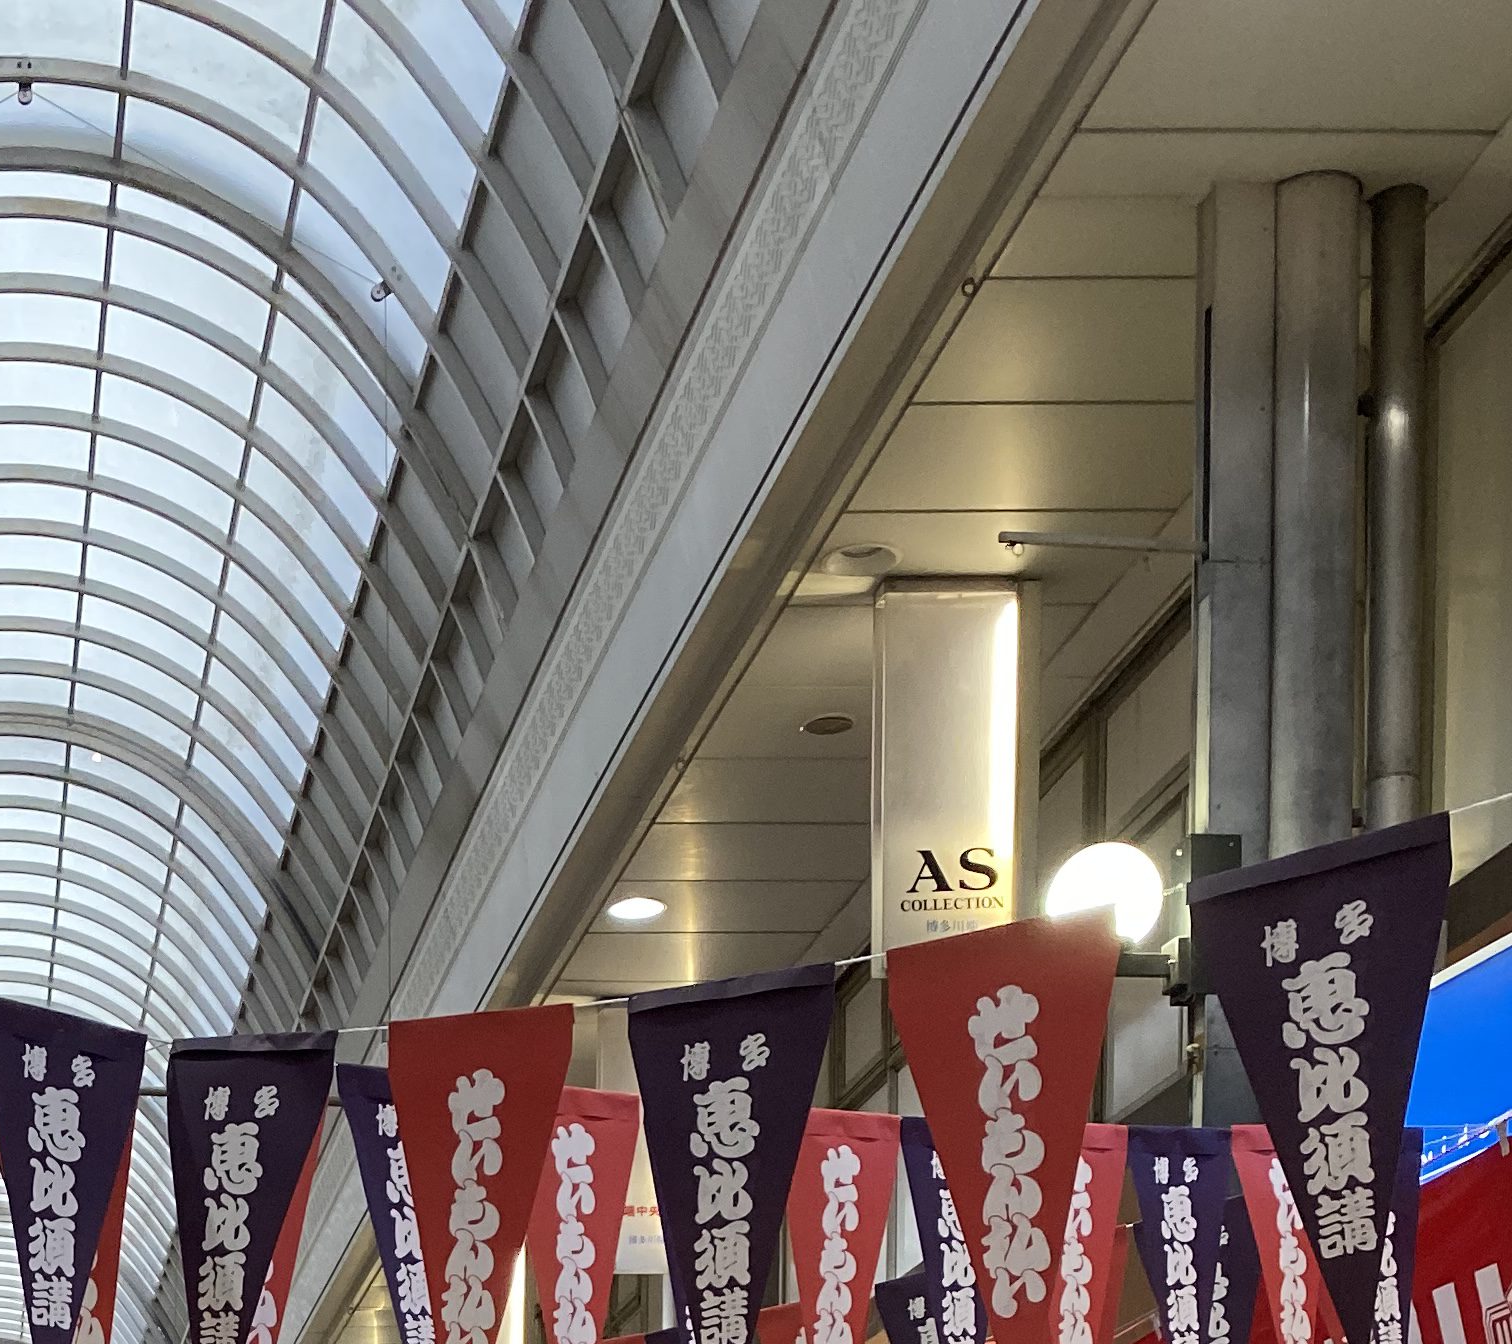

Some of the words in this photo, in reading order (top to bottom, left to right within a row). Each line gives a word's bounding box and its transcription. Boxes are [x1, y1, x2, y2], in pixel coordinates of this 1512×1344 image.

[907, 847, 998, 894] AS
[899, 896, 1005, 912] COLLECTION
[1261, 900, 1373, 966] 博多
[22, 1044, 95, 1087] 博多
[680, 1033, 770, 1081] 博多
[204, 1086, 279, 1120] 博多
[1282, 952, 1378, 1258] 恵比須講
[968, 985, 1051, 1318] せいもん払い
[1154, 1157, 1198, 1184] 博多
[28, 1087, 85, 1329] 恵比須講
